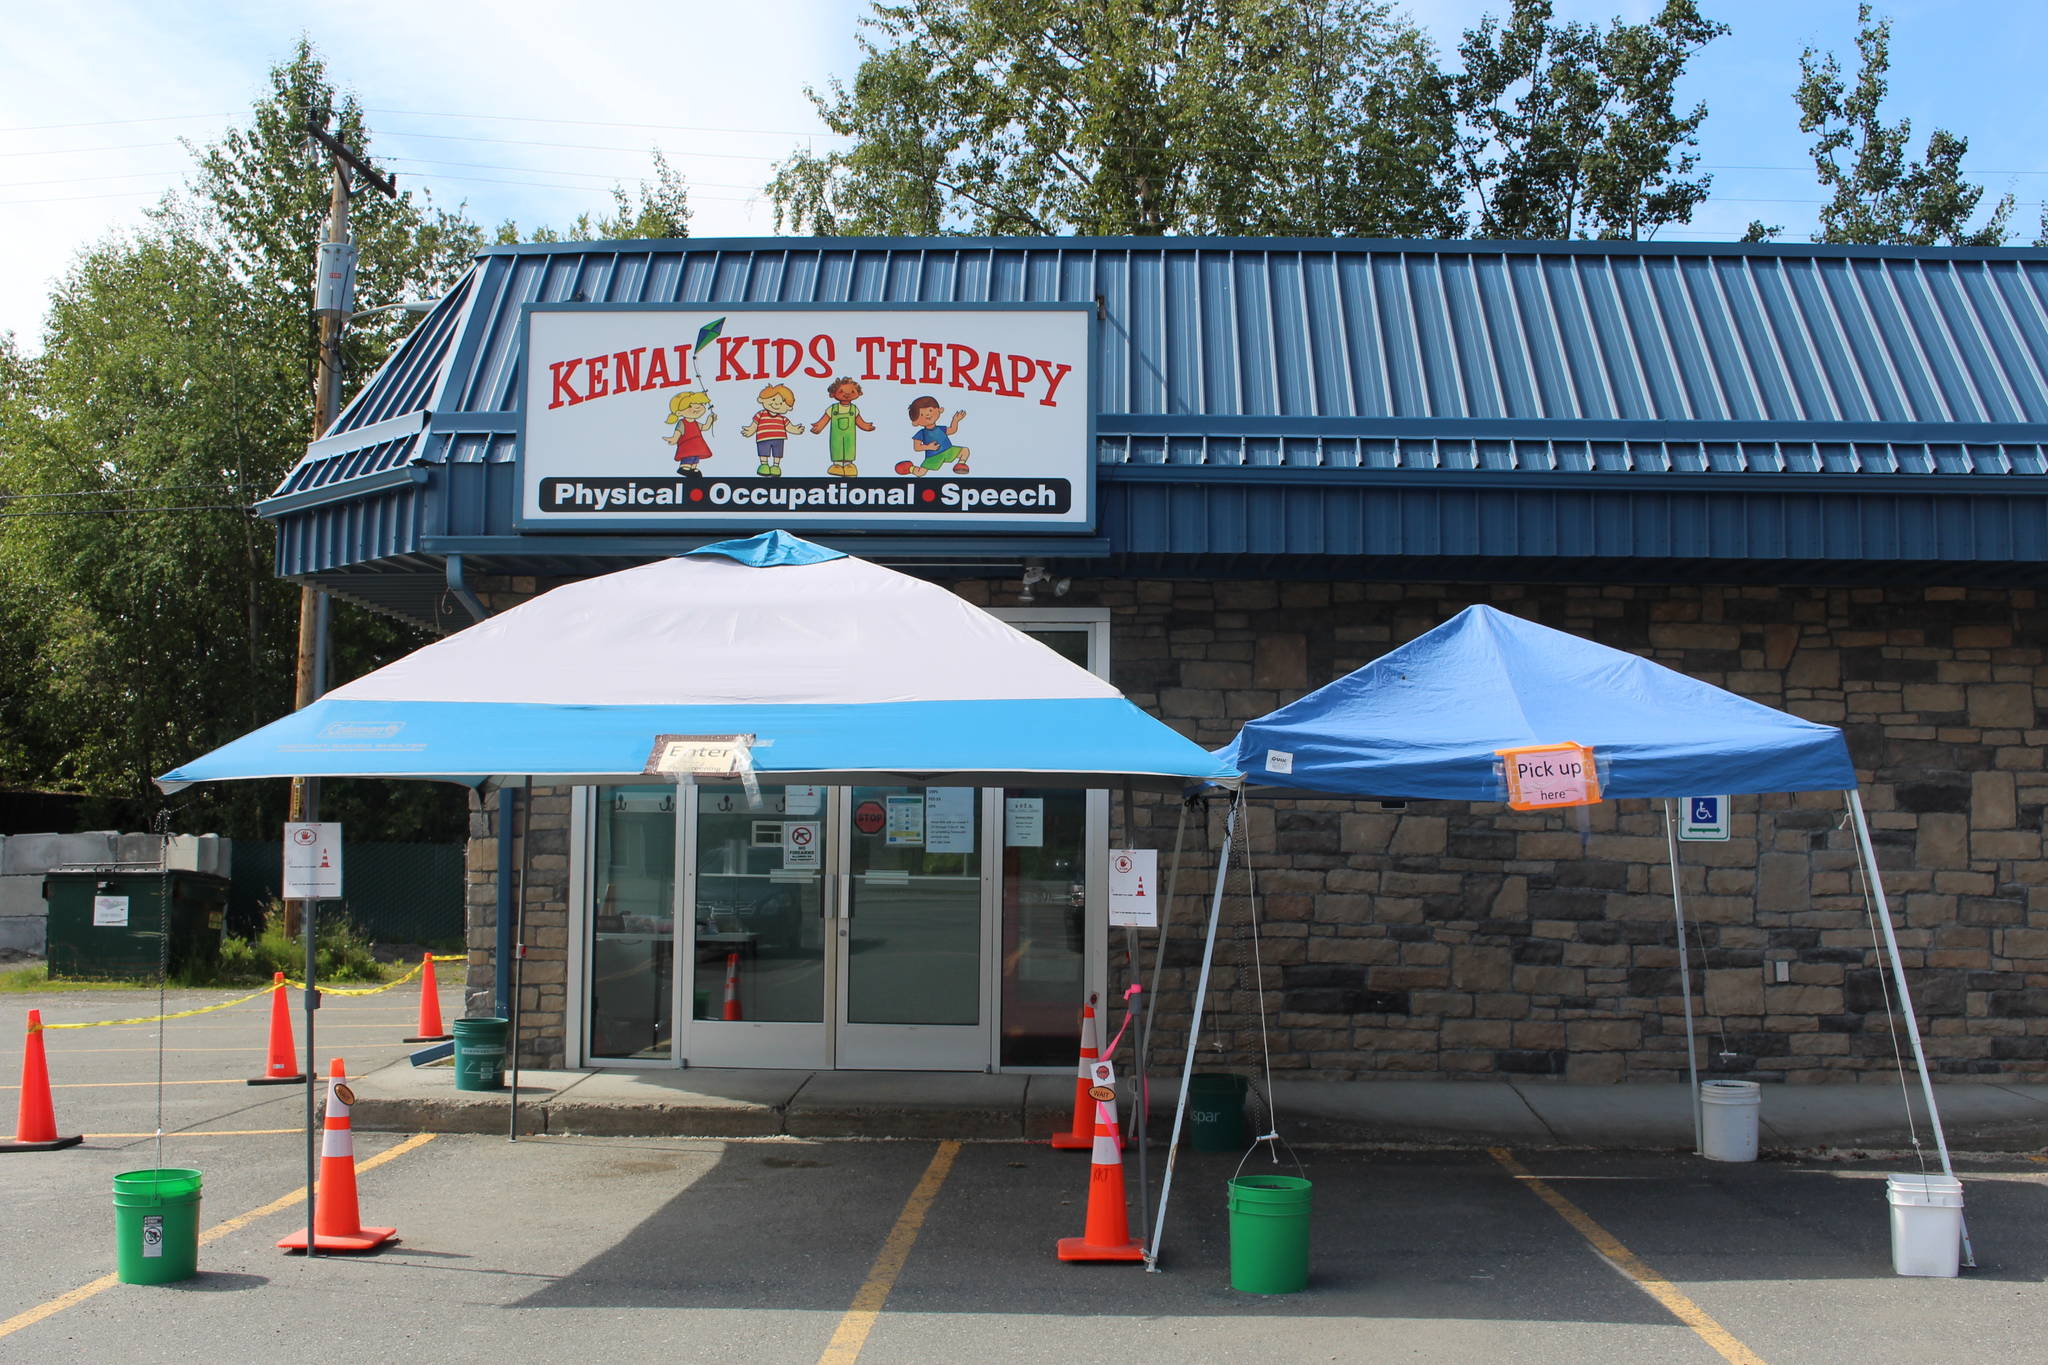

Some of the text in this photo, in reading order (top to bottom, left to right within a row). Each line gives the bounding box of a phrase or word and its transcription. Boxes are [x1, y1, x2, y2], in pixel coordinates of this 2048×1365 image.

[548, 334, 1072, 410] KENAI KIDS THERAPY
[555, 482, 1056, 511] Physical Occupational Speech
[1517, 760, 1582, 779] Pick up
[1540, 790, 1566, 801] here
[1093, 1090, 1109, 1098] WAIT
